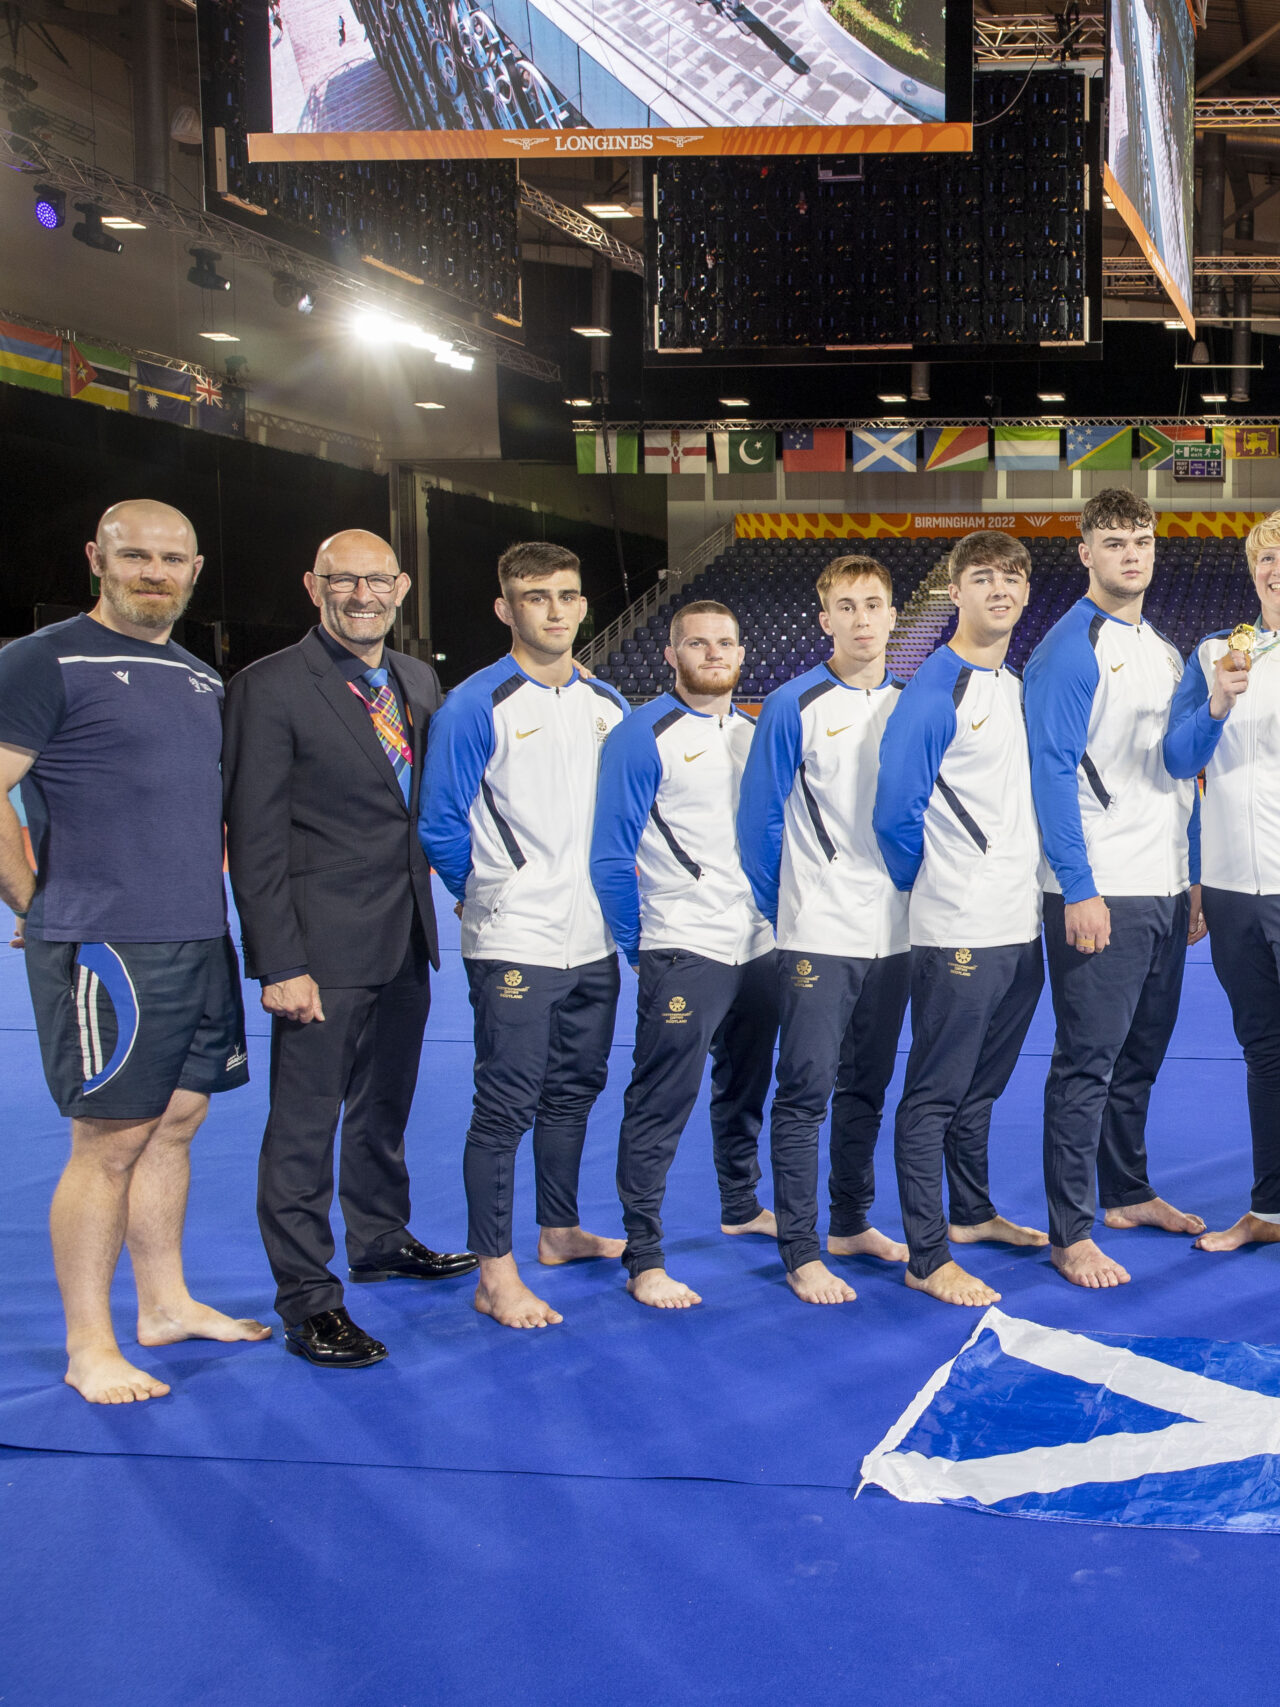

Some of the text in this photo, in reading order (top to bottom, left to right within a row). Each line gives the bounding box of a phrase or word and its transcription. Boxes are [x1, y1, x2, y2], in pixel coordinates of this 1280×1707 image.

[554, 134, 654, 151] LONGINES
[915, 516, 1016, 529] BIRMINGHAM 2022
